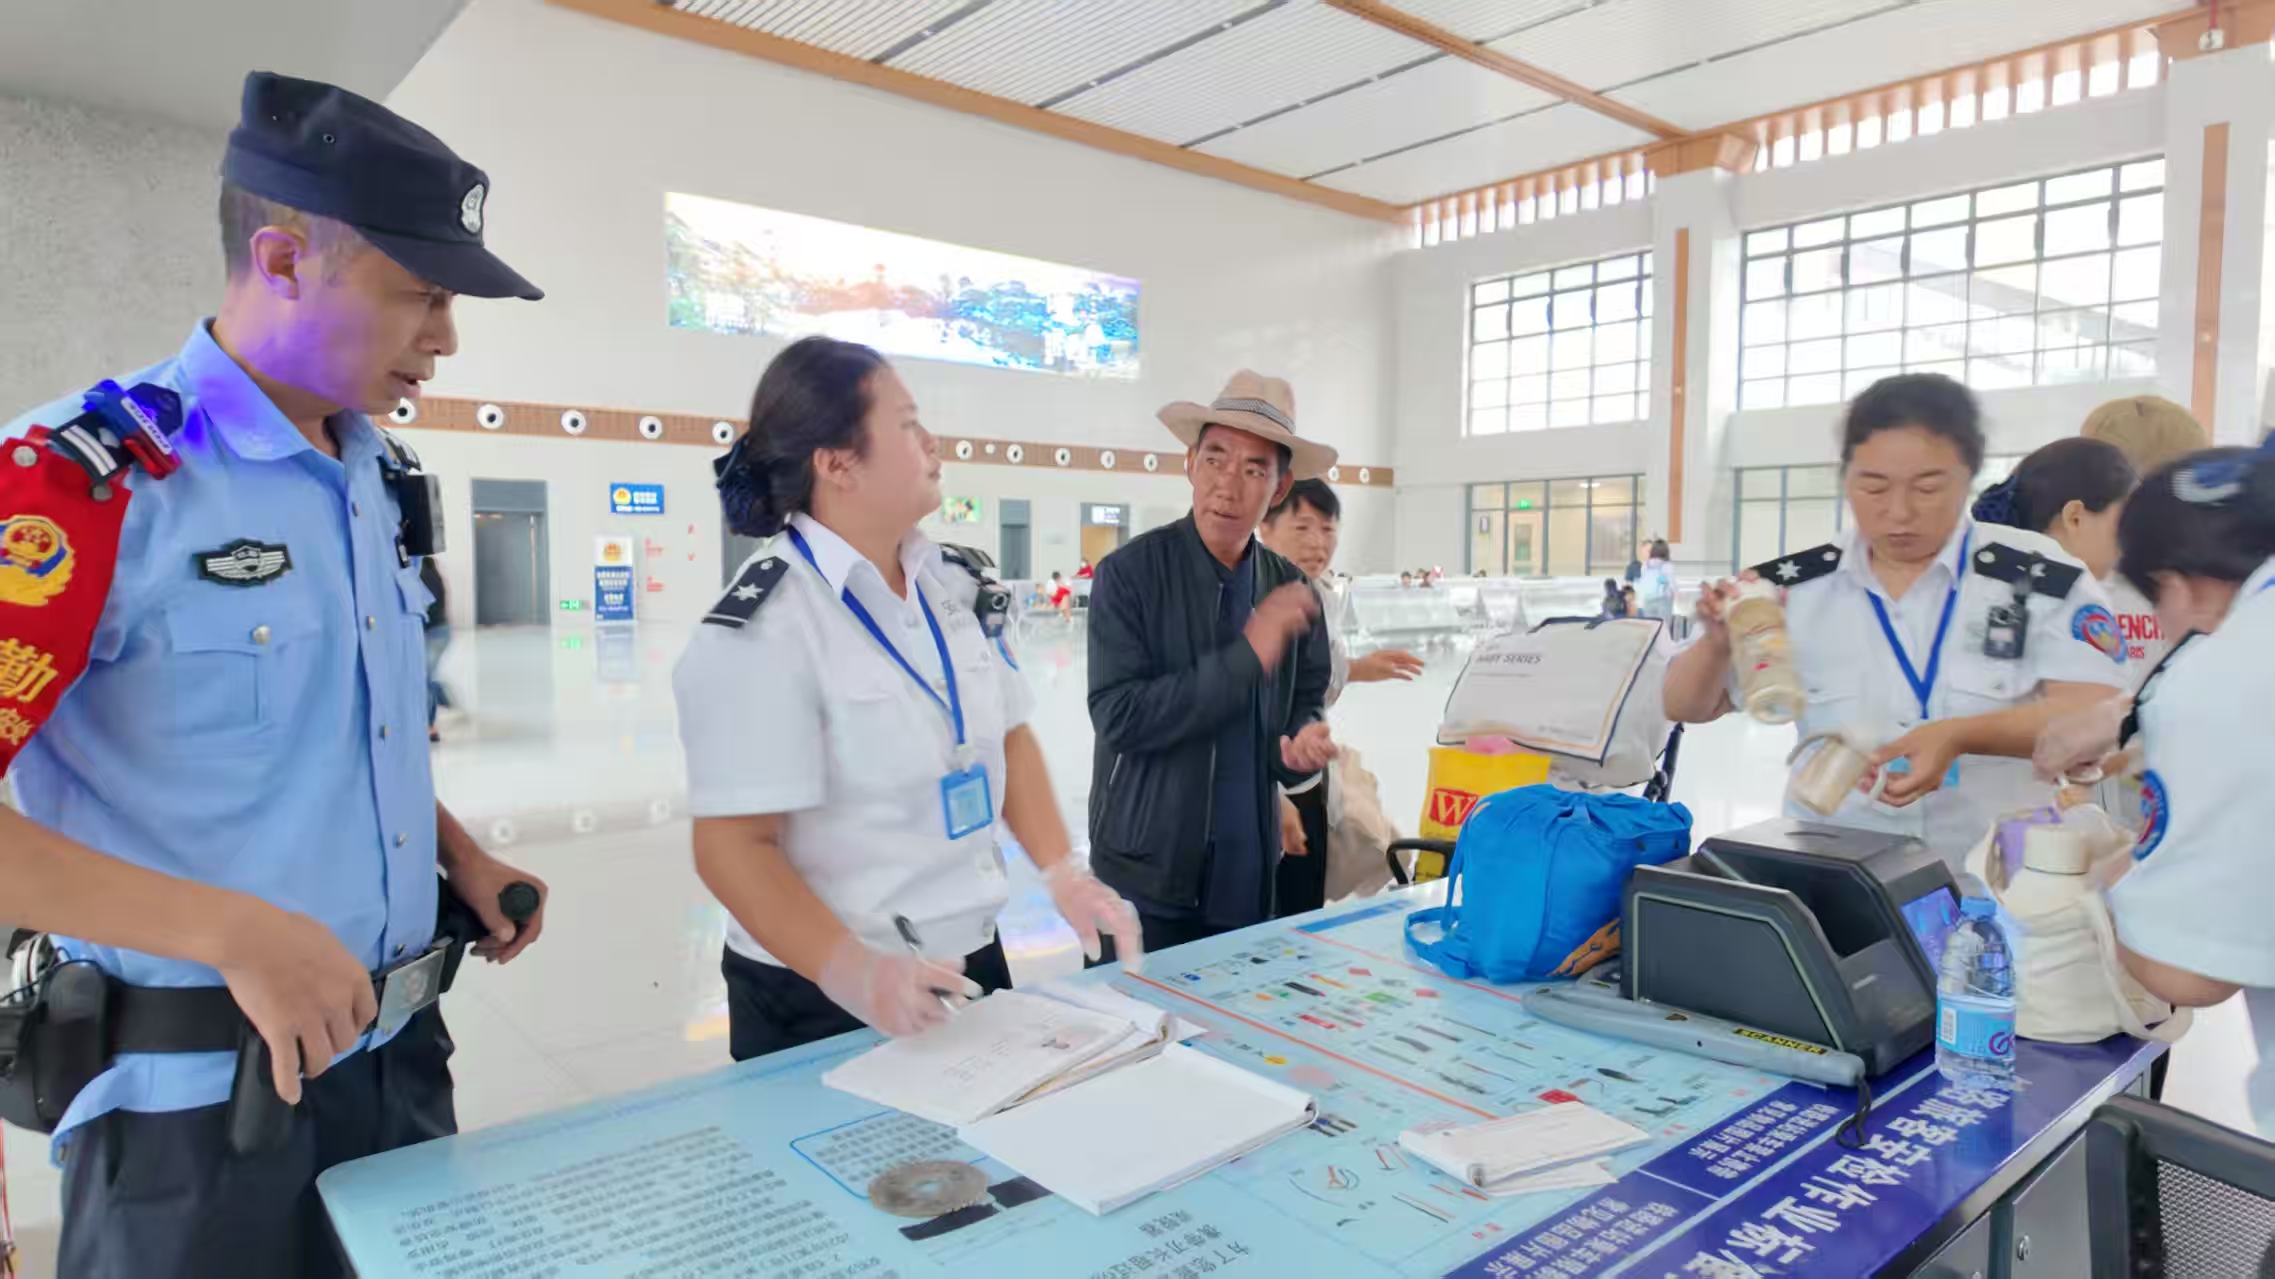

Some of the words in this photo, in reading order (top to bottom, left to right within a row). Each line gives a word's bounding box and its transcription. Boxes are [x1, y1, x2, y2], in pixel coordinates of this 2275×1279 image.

[1739, 1029, 1823, 1054] SCANNER
[1664, 1078, 2016, 1279] 路旅客安检作业标准
[1526, 1201, 1680, 1279] 铁路进站乘车限制
